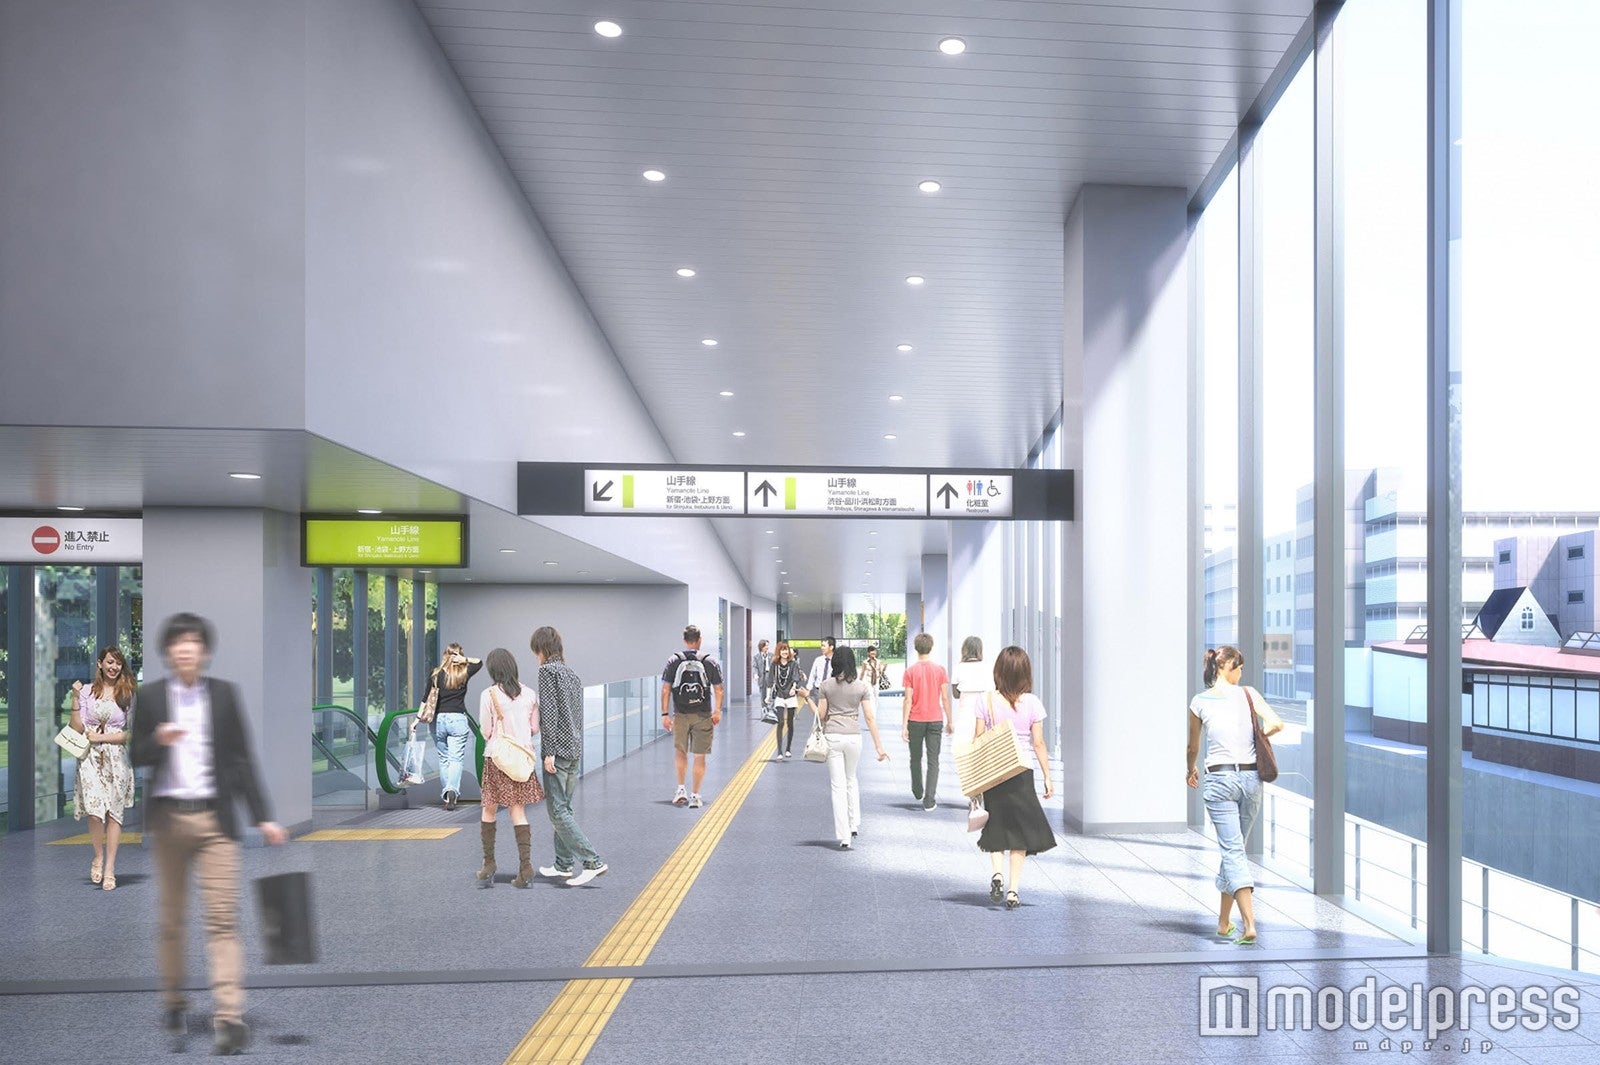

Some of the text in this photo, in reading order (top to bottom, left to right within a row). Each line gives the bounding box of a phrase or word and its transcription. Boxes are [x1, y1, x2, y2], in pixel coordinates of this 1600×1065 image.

[666, 475, 696, 486] 山手線
[827, 477, 857, 488] 山手線
[390, 525, 419, 535] 山手線
[64, 531, 110, 542] 進入禁止
